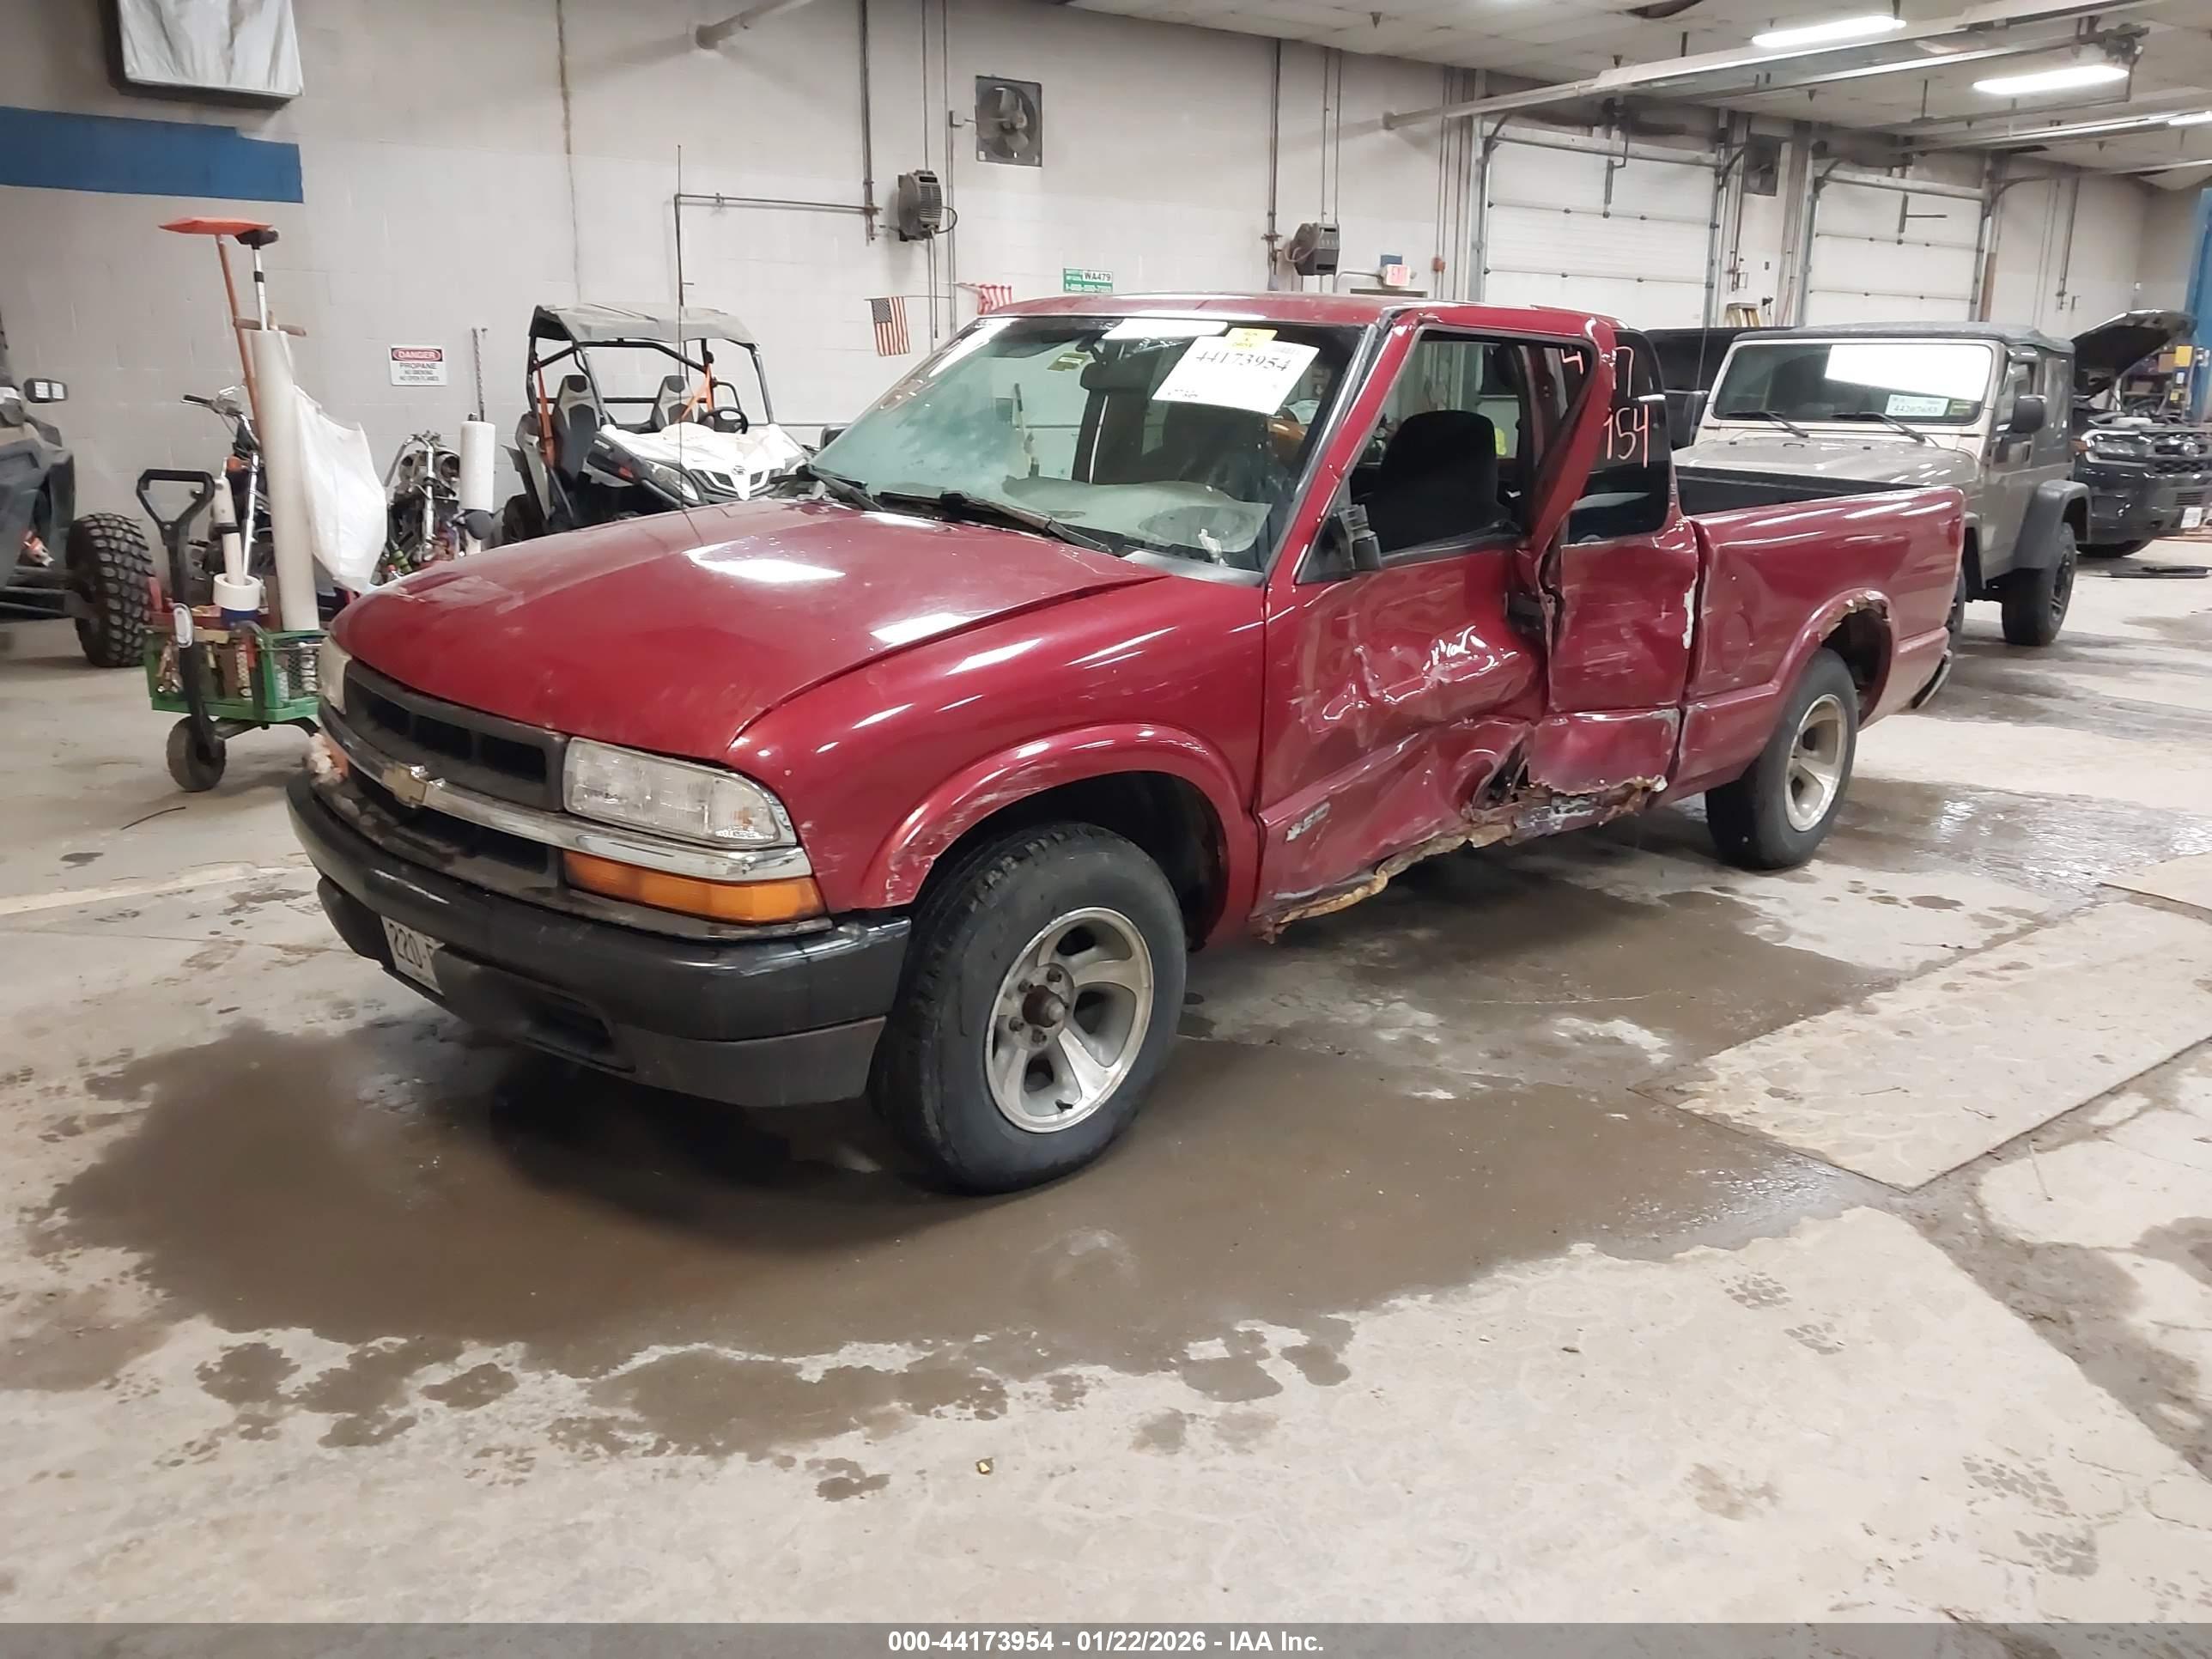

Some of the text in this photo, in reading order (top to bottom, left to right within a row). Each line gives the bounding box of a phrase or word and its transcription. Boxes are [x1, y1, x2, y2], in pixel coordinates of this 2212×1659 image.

[1085, 271, 1111, 281] WA479
[398, 350, 435, 359] DANGER
[1196, 351, 1291, 372] 44173954
